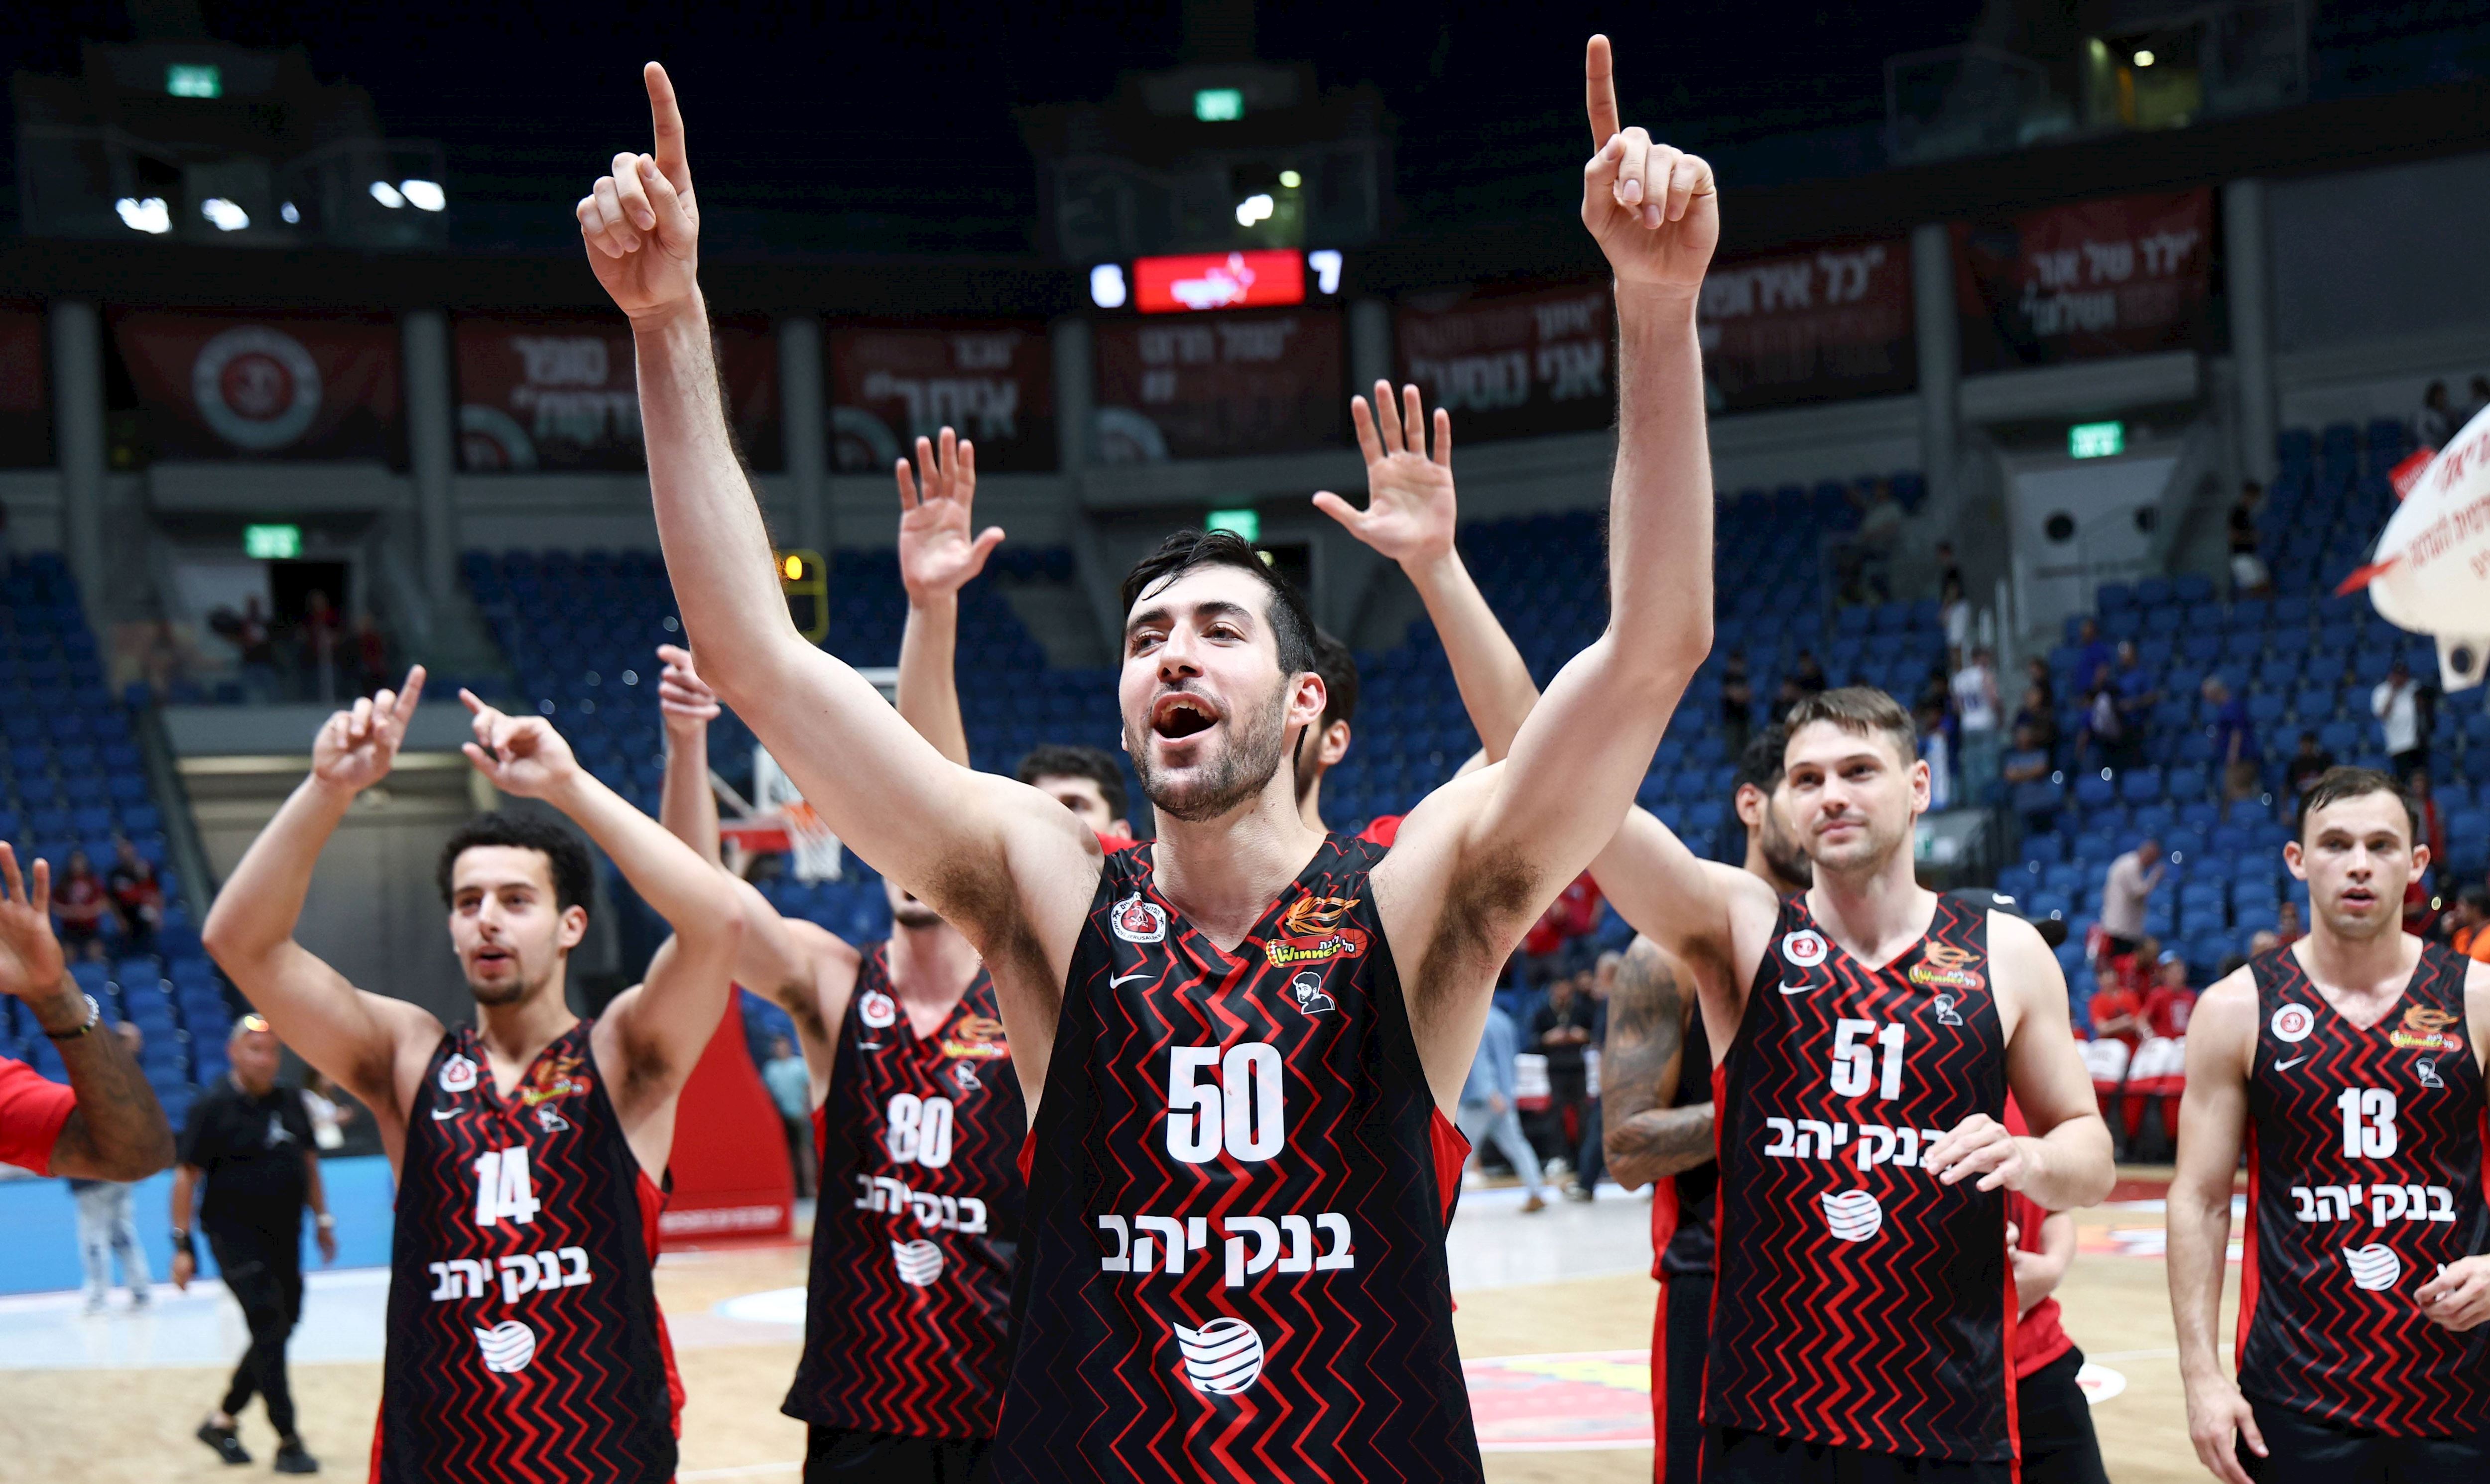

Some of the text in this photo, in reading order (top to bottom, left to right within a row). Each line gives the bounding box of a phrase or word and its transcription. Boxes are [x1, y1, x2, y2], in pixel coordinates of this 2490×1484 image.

[1308, 249, 1343, 295] 7
[1342, 939, 1355, 952] סל
[1830, 1017, 1906, 1101] 51
[887, 1093, 954, 1168] 80
[1166, 1042, 1285, 1164] 50
[1764, 1117, 1849, 1161] יהב
[2337, 1087, 2398, 1159] 13
[474, 1146, 541, 1226] 14
[2291, 1183, 2457, 1228] בנק יהב
[429, 1245, 592, 1304] בנק יהב
[1098, 1212, 1354, 1287] בנק יהב
